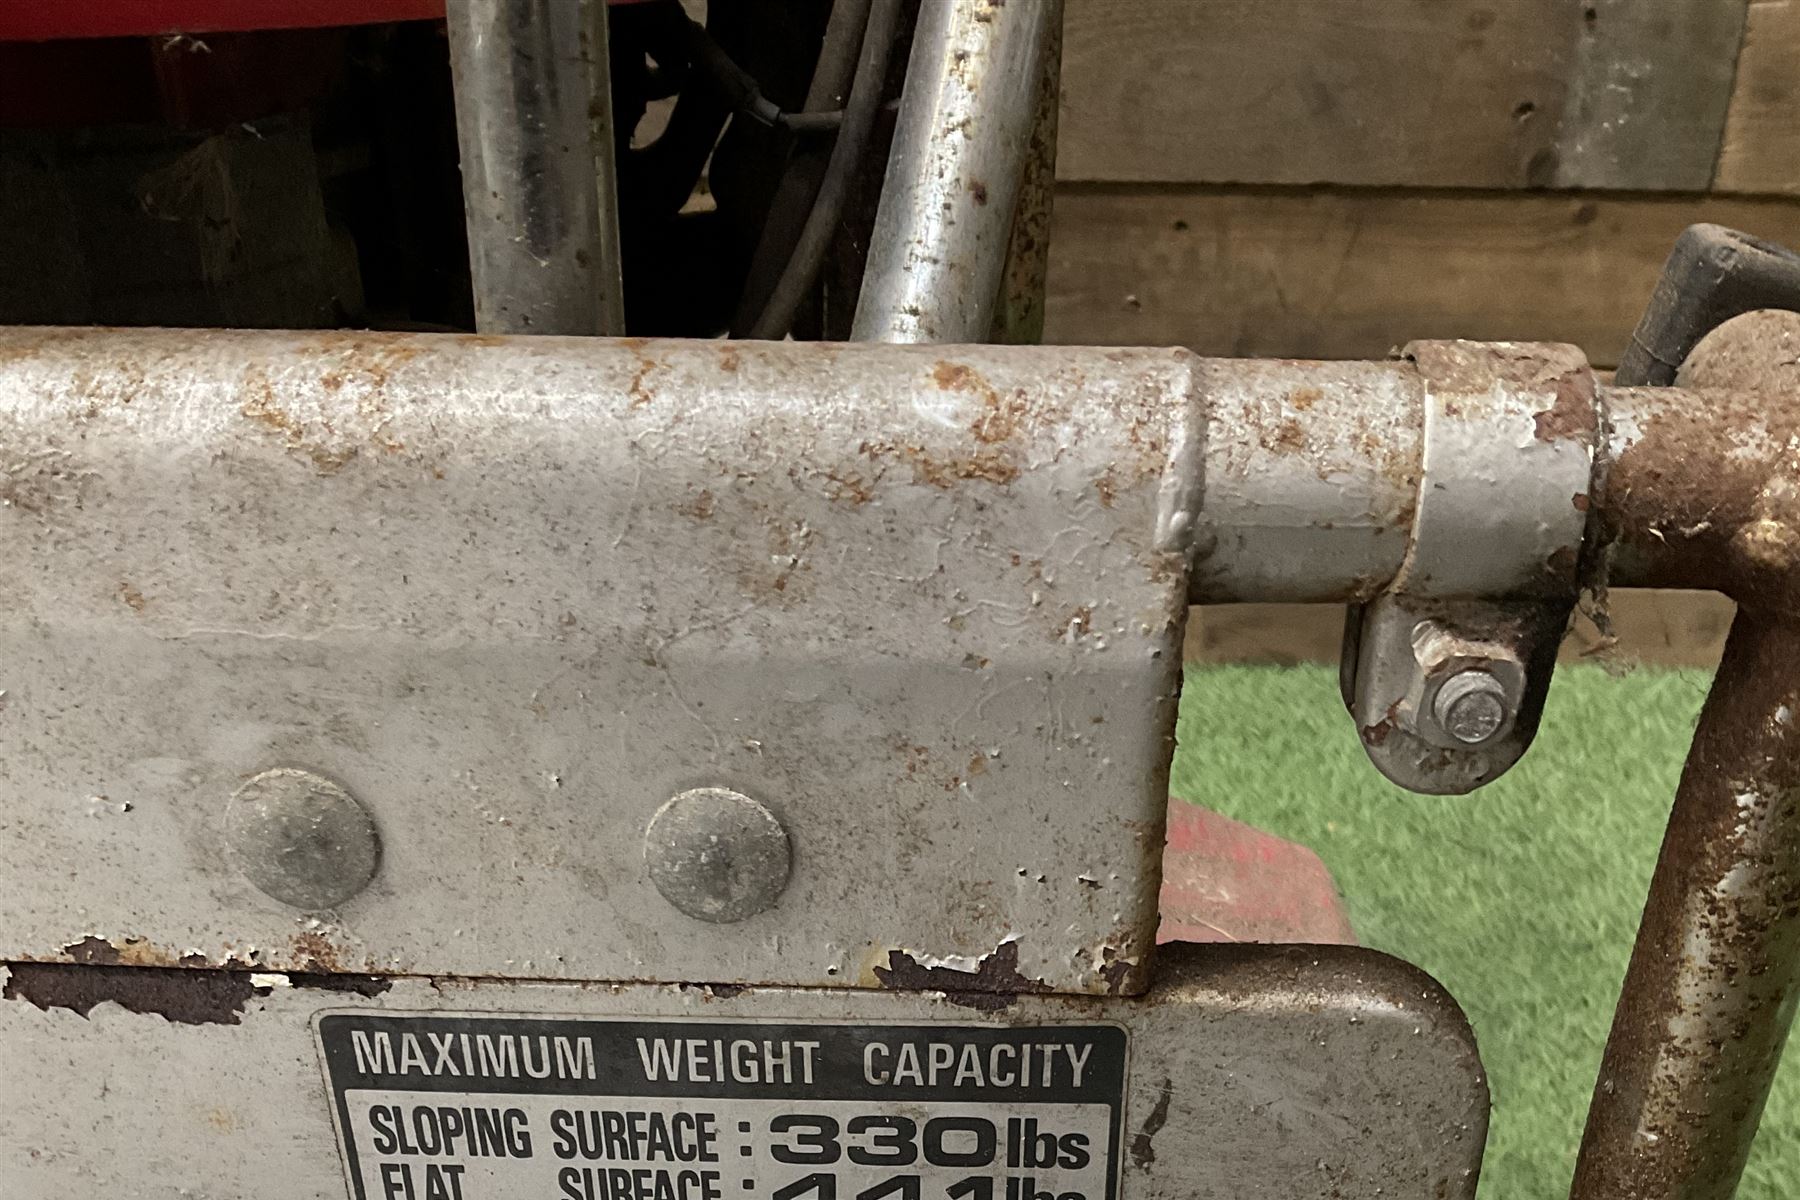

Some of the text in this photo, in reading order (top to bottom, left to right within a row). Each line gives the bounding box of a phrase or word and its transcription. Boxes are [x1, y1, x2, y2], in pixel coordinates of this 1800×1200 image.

[351, 1030, 1093, 1088] MAXIMUM WEIGHT CAPACITY
[369, 1105, 533, 1158] SLOPING
[550, 1109, 719, 1162] SURFACE
